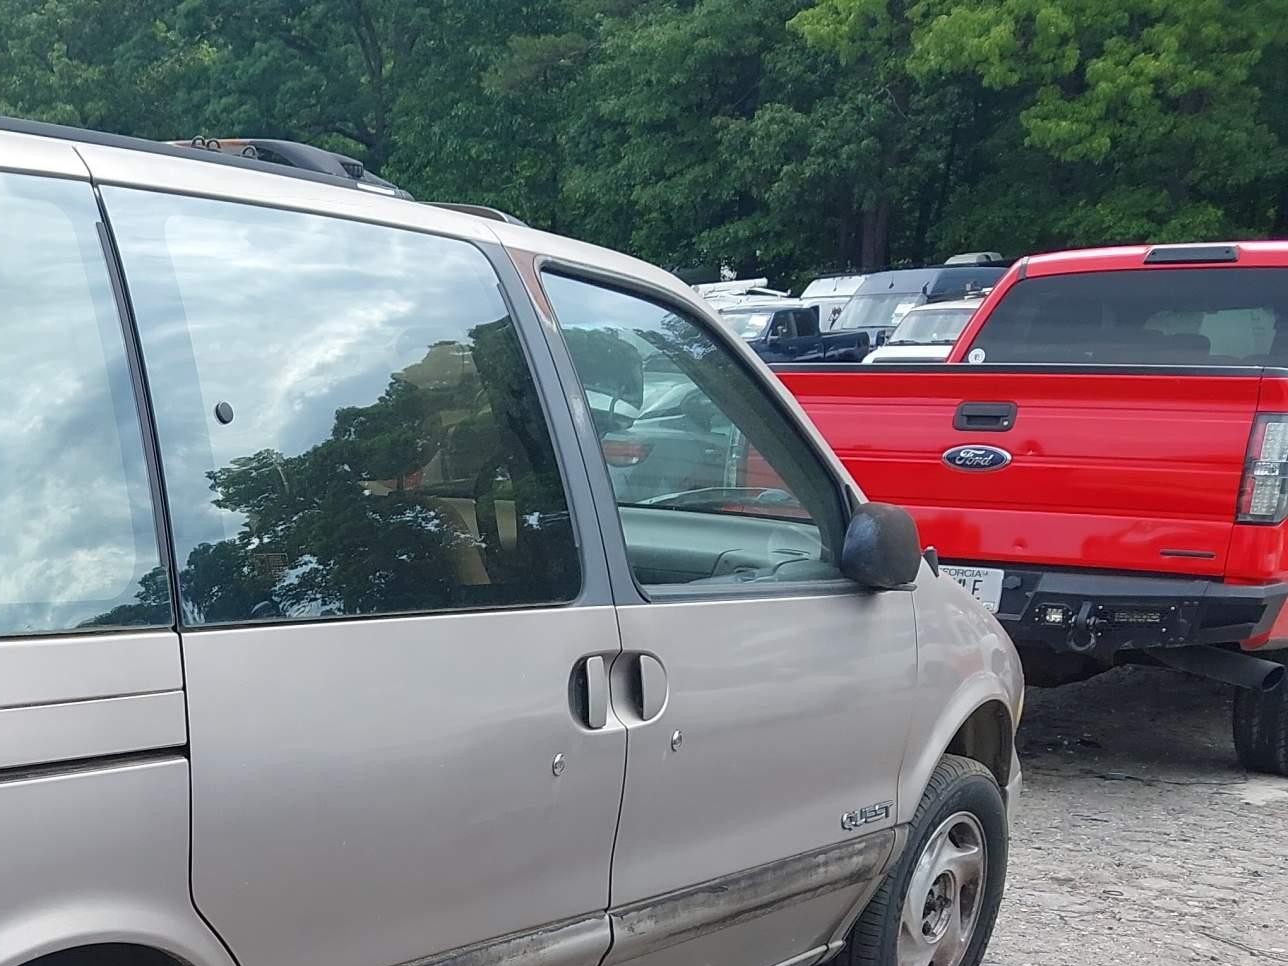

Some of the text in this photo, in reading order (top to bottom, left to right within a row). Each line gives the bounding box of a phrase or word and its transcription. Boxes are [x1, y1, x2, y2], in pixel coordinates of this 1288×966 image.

[955, 448, 994, 466] Ford
[939, 567, 982, 579] EORGIA
[841, 800, 894, 831] QUEST
